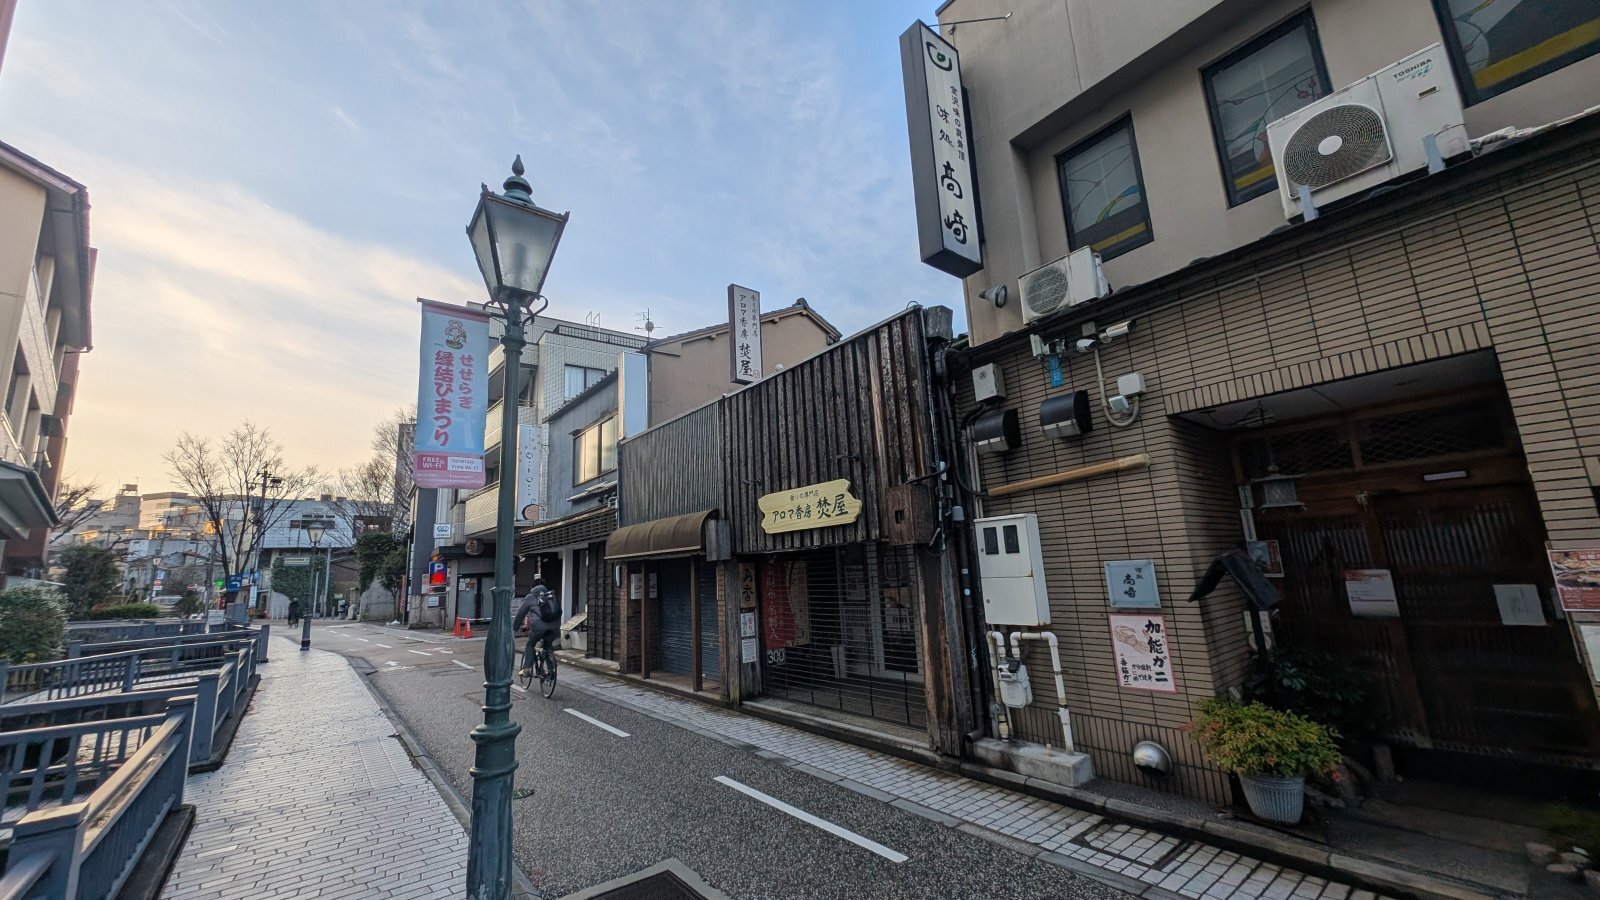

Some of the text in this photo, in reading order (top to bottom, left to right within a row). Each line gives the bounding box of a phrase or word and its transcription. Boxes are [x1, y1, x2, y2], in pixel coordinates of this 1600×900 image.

[1393, 58, 1433, 79] TOSHIBA
[433, 350, 454, 447] 縁結びまつり
[458, 354, 474, 410] せせらぎ
[772, 493, 849, 524] アロマ香房 焚屋
[434, 563, 444, 573] P
[1144, 619, 1168, 682] 加能ガニ
